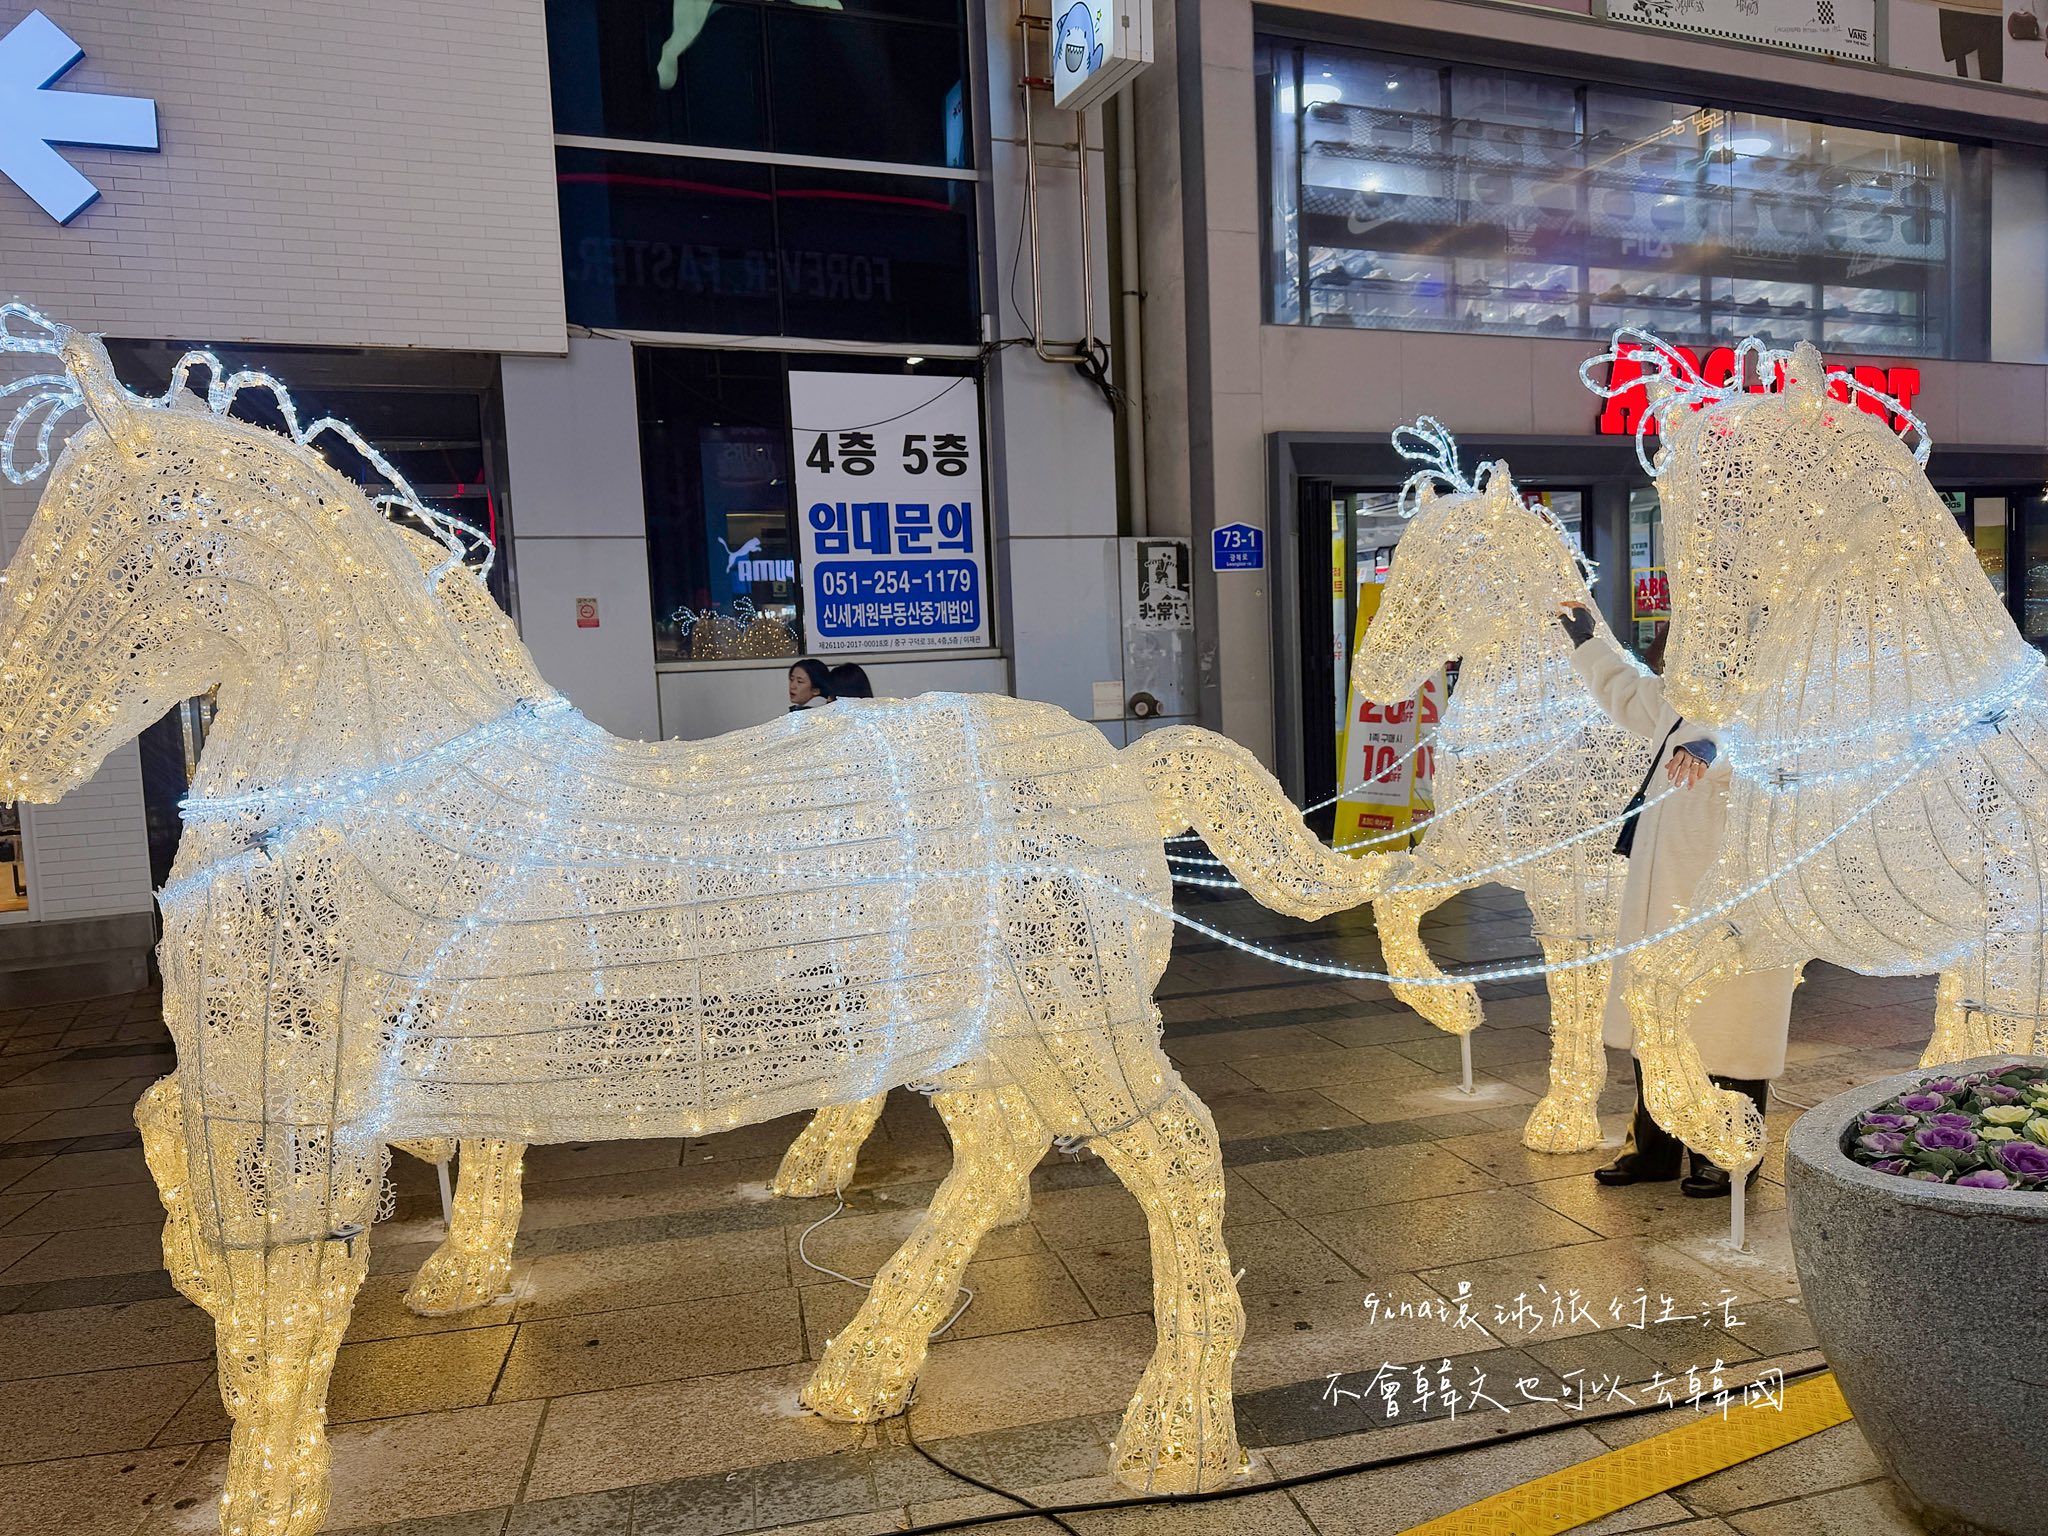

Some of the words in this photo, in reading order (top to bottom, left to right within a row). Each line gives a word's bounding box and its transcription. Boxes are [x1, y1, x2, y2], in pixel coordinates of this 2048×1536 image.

[1848, 27, 1867, 41] VANS
[1621, 232, 1673, 258] FILA
[806, 432, 877, 476] 4층
[902, 434, 969, 477] 5층
[808, 502, 974, 555] 임대문의
[1222, 530, 1256, 548] 73-1
[822, 569, 971, 596] 051-254-1179
[1637, 577, 1669, 597] ABC
[823, 600, 974, 629] 신세계원부동산중개법인
